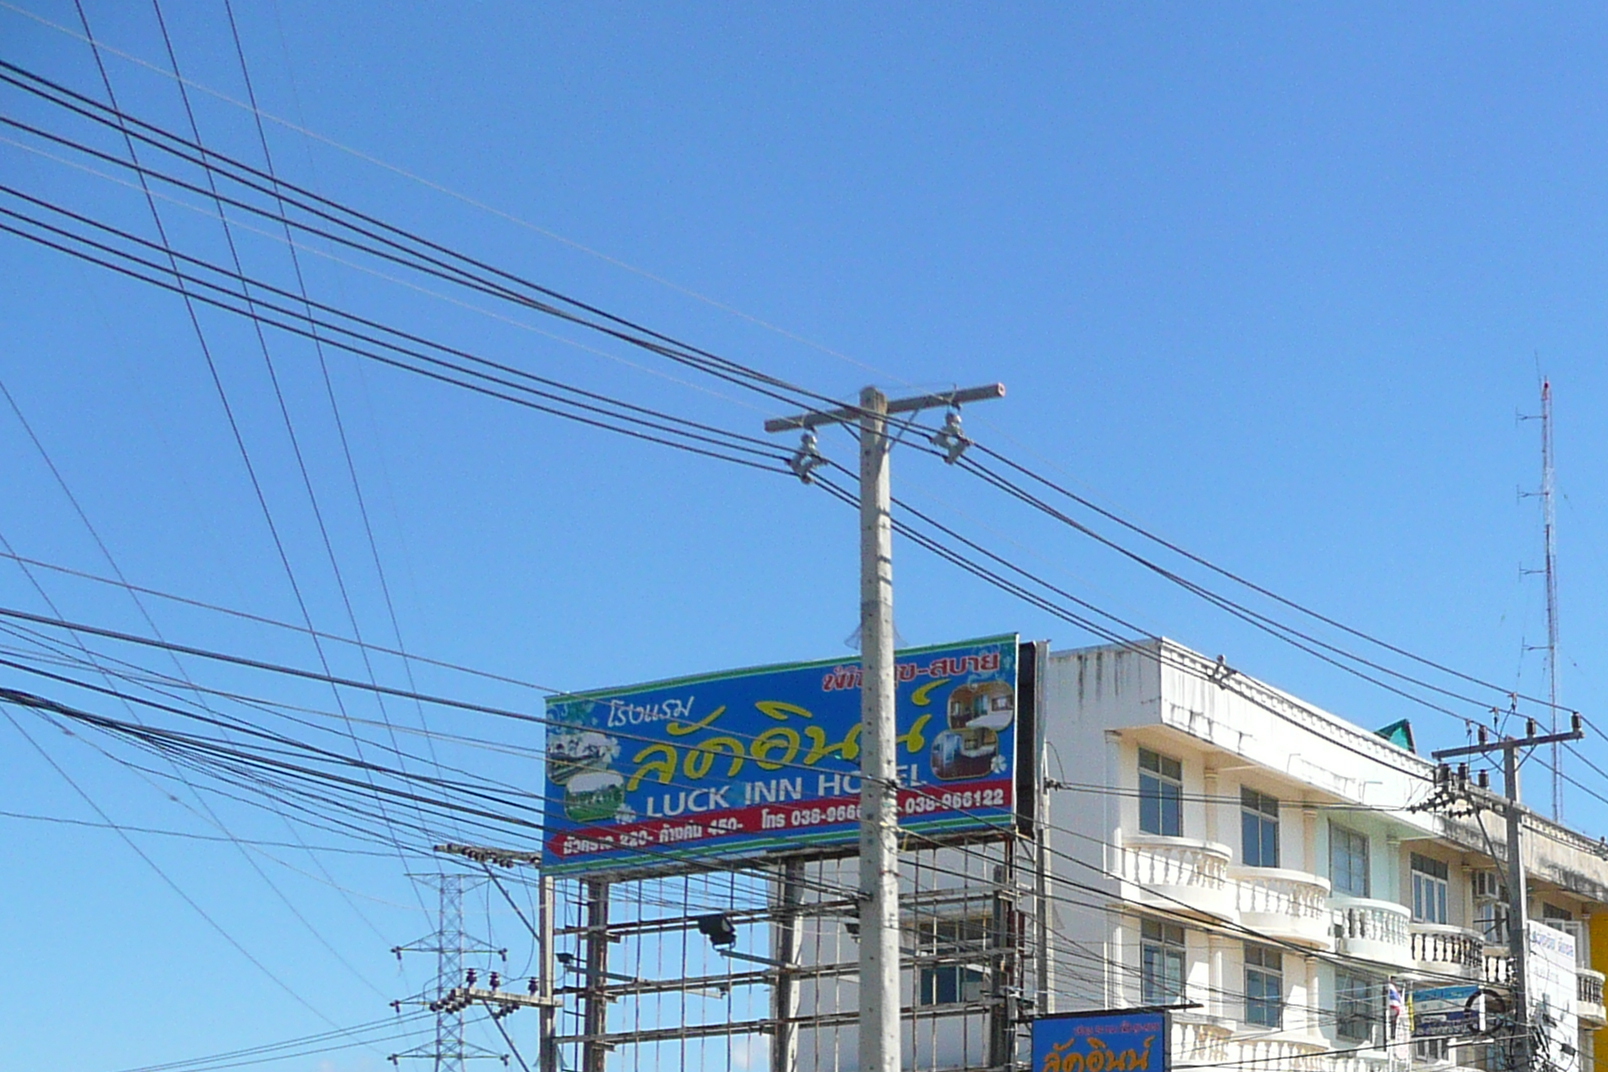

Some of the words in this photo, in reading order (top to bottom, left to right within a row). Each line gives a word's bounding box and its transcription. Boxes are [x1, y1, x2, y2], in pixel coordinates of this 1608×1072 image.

[607, 696, 695, 728] โรงแรม
[646, 784, 731, 819] LUCK
[744, 776, 802, 806] INN
[818, 763, 928, 797] HOEL
[762, 808, 786, 830] โทร
[905, 788, 1004, 815] 038-966122
